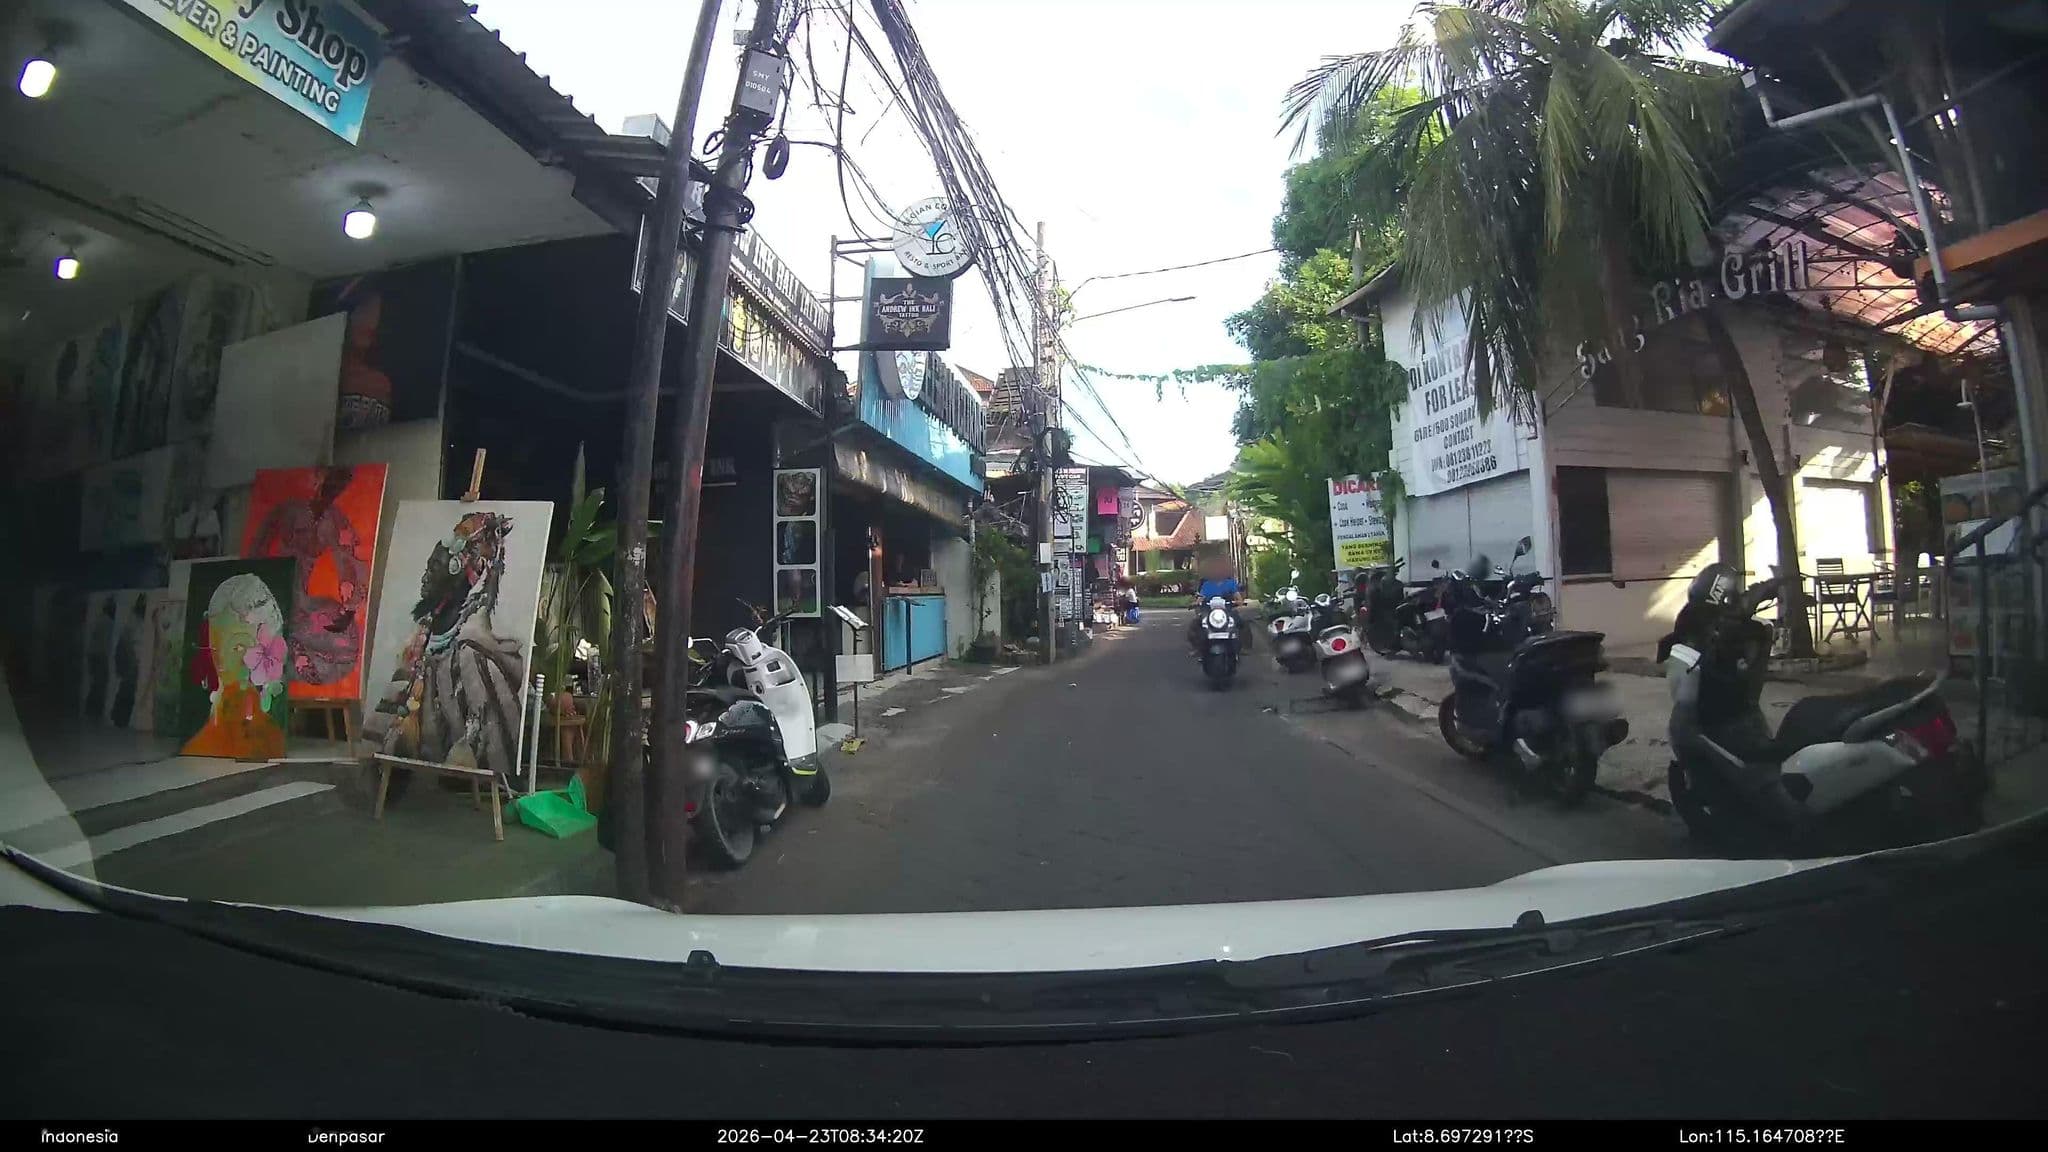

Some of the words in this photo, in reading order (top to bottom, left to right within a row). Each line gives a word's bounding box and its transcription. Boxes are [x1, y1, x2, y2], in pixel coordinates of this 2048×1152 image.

[159, 0, 218, 35] VER
[220, 22, 238, 48] &
[240, 32, 340, 112] PAINTING
[276, 0, 368, 90] Shop
[932, 259, 954, 270] SPORT
[753, 234, 778, 282] INK
[775, 259, 800, 306] BALI
[800, 284, 830, 337] TATTOO
[1652, 277, 1707, 325] Ria
[1721, 239, 1808, 300] Grill
[881, 305, 907, 313] ANDREW
[908, 305, 919, 313] INK
[921, 305, 936, 313] BALI
[1409, 366, 1423, 391] DI
[1425, 384, 1448, 416] FOR
[1443, 425, 1474, 450] CONTACT
